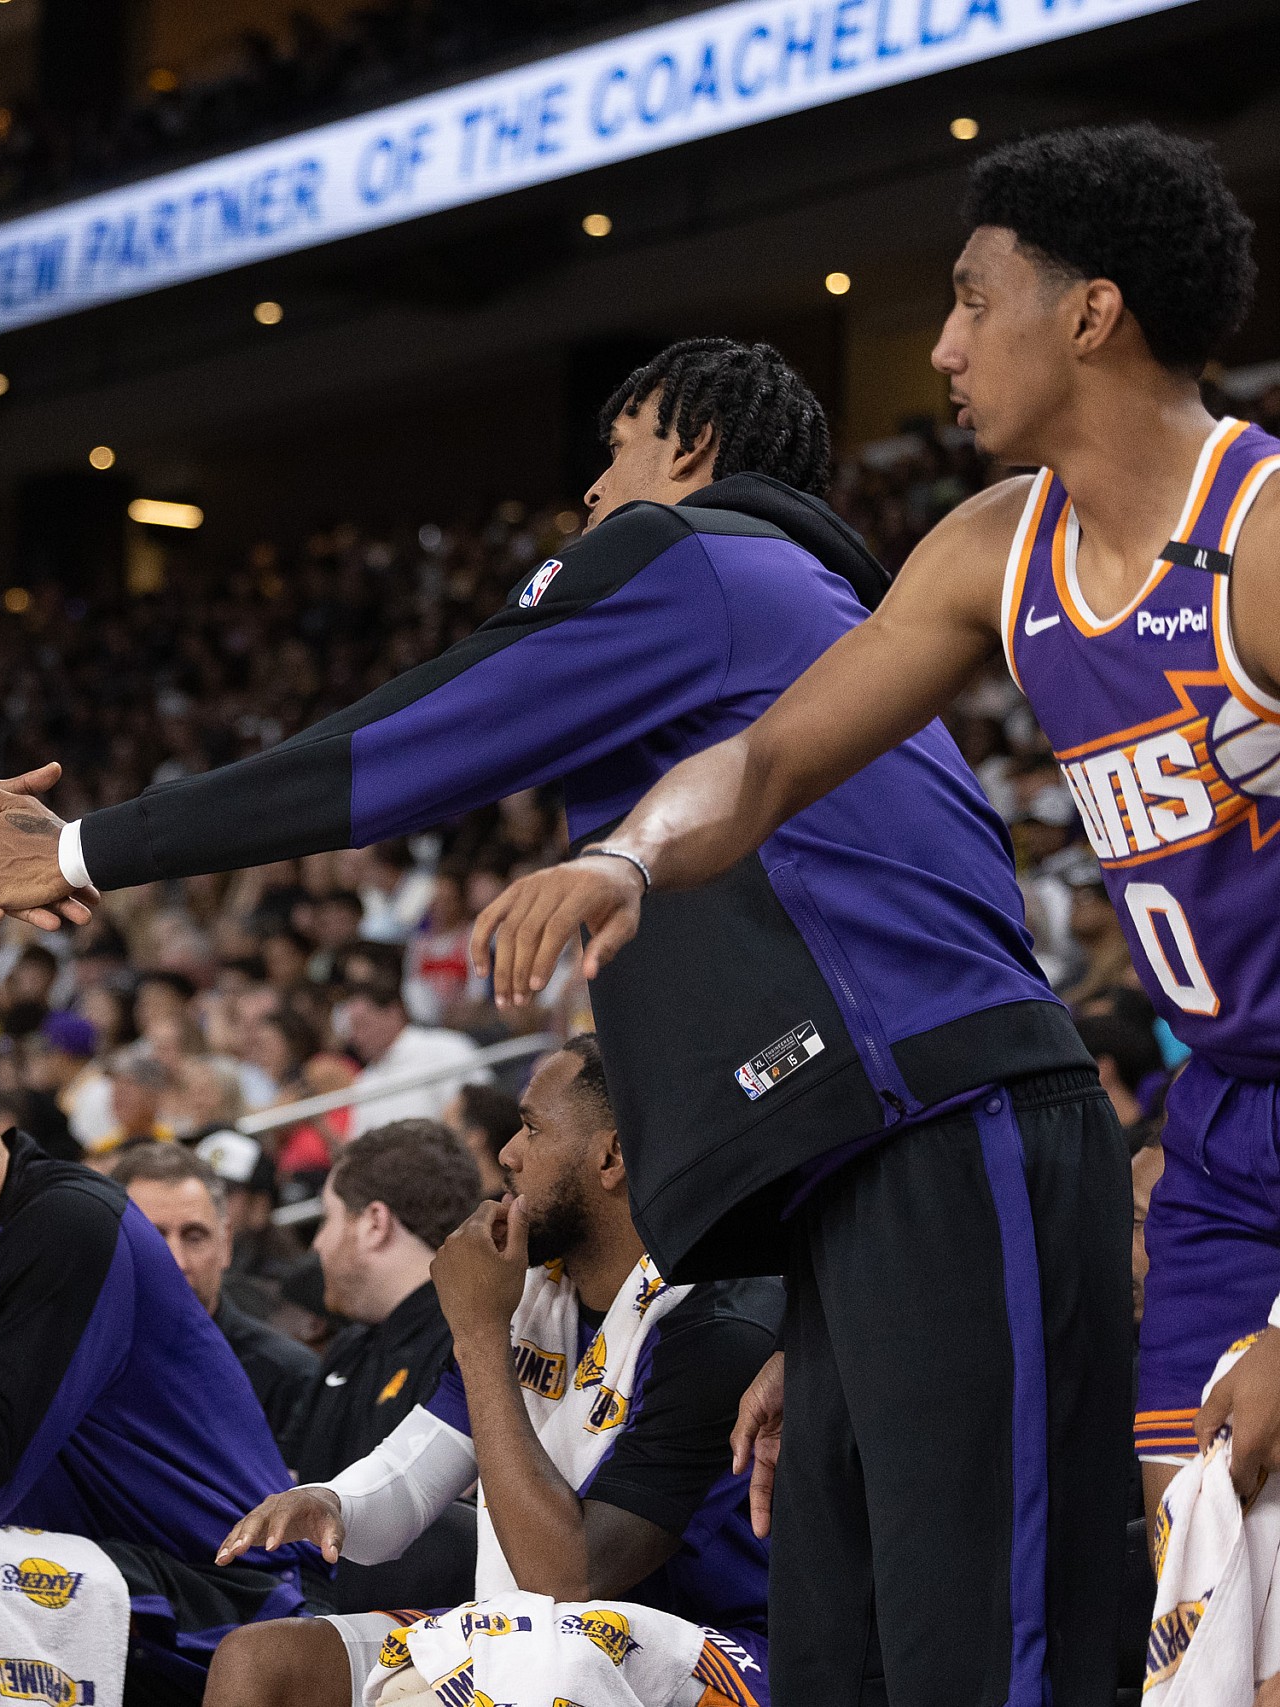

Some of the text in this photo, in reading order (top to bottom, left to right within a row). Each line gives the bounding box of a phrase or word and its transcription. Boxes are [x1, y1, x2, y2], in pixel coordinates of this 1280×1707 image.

[77, 157, 325, 280] PARTNER
[355, 122, 435, 206] OF
[458, 81, 570, 183] THE
[589, 0, 1004, 139] COACHELLA
[1193, 549, 1209, 569] AL
[1137, 606, 1208, 641] PayPal
[1060, 731, 1214, 859] UNS
[1124, 882, 1220, 1018] 0
[753, 1059, 766, 1071] XL
[786, 1053, 798, 1067] 15
[4, 1661, 63, 1704] PRIME
